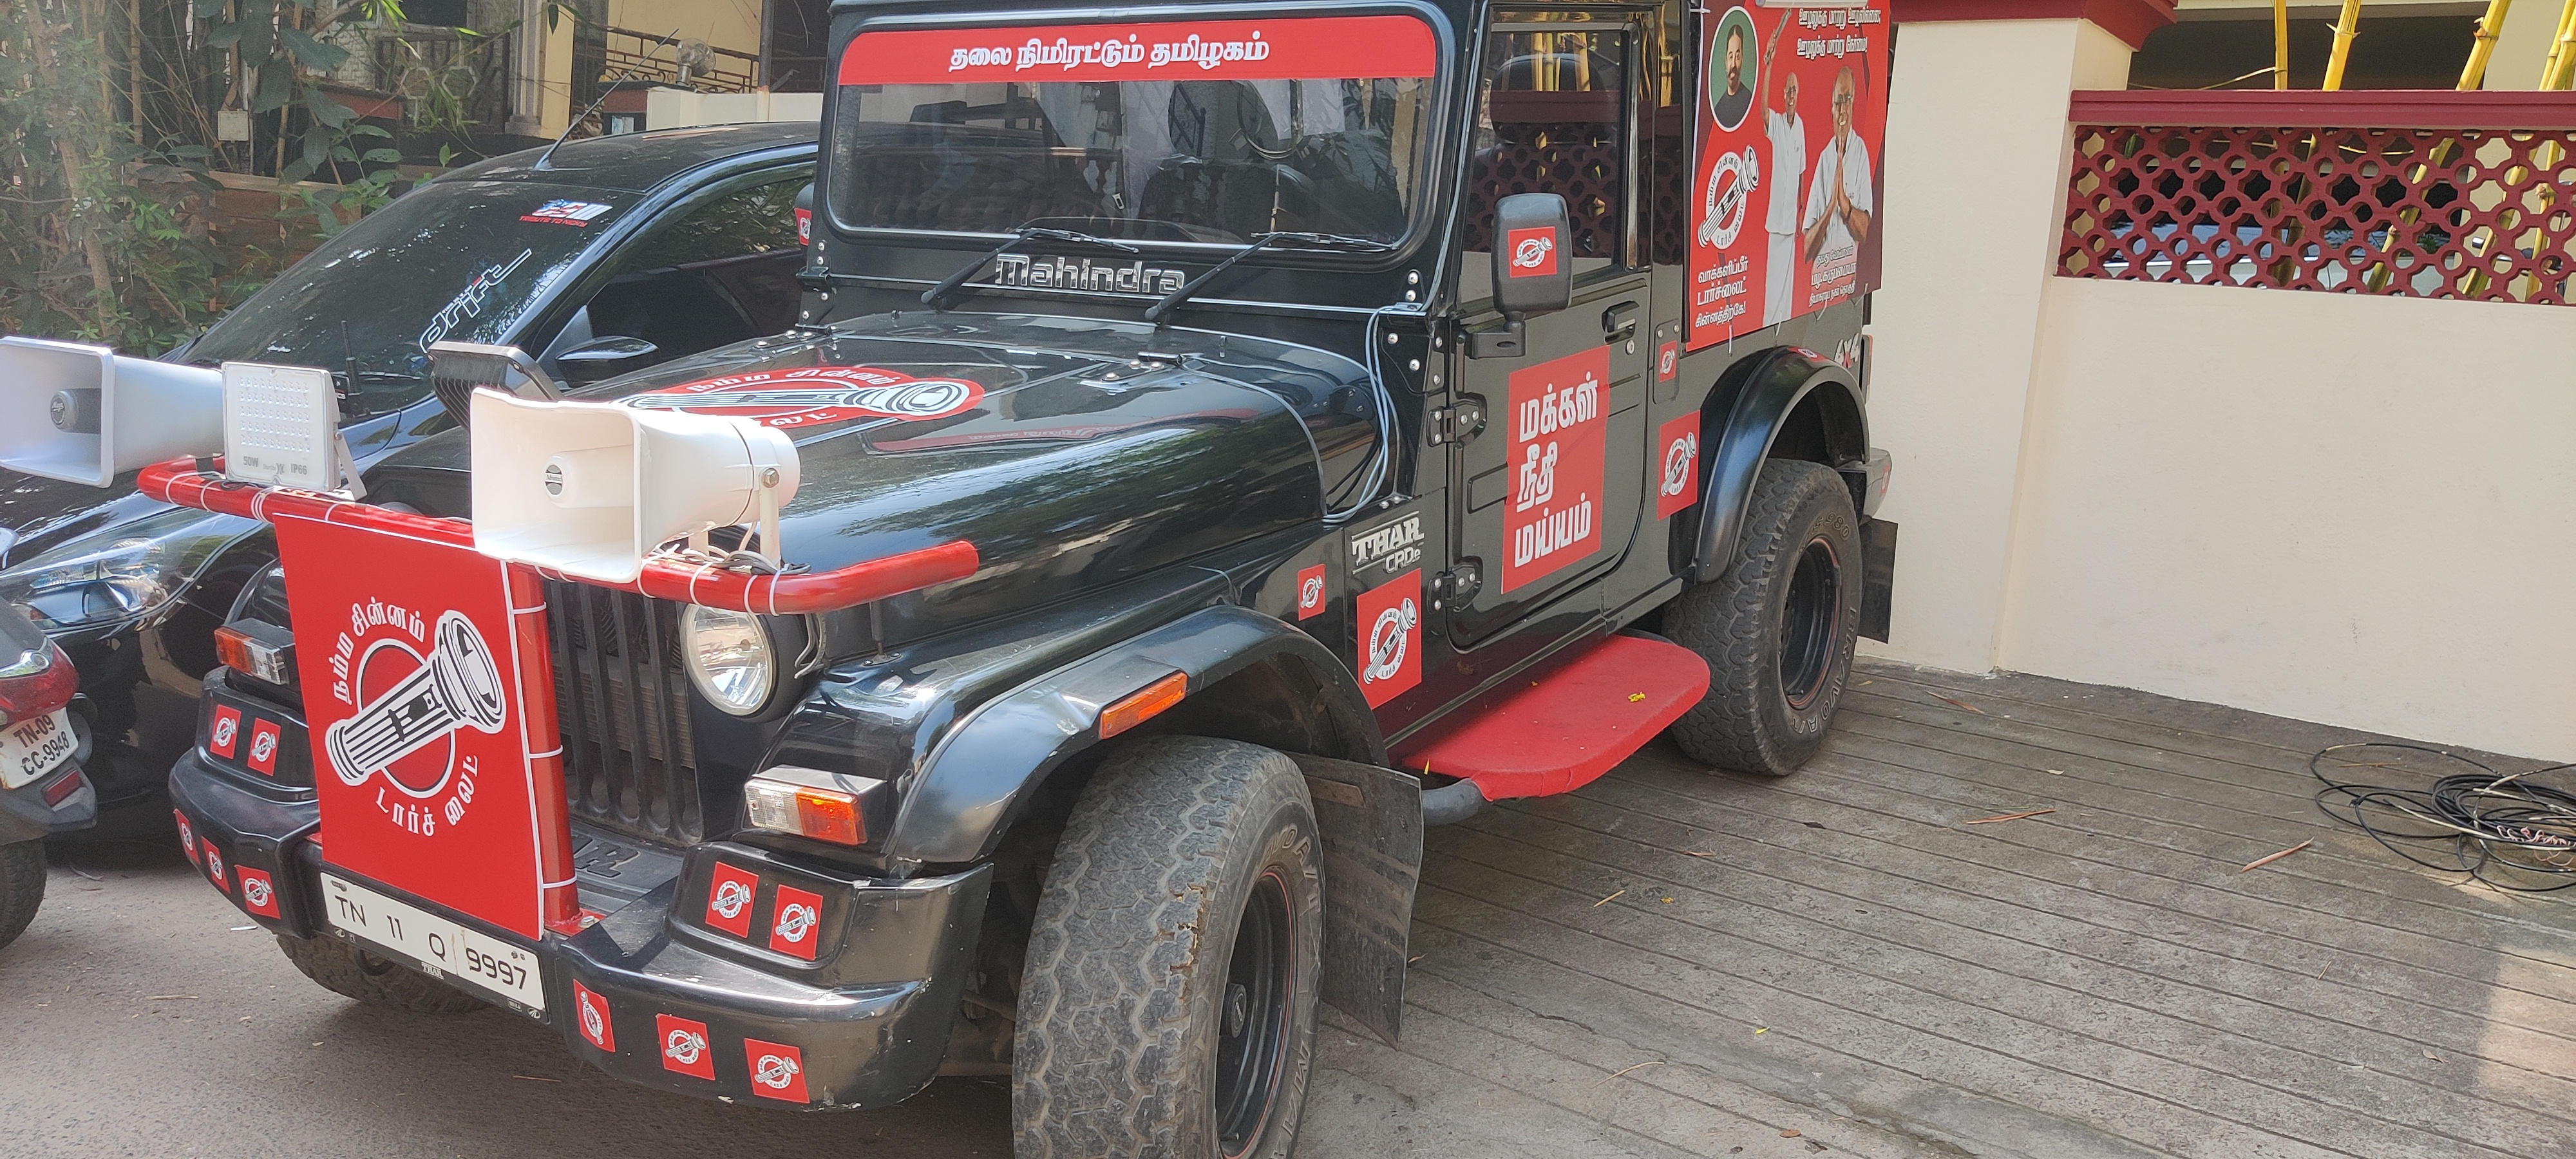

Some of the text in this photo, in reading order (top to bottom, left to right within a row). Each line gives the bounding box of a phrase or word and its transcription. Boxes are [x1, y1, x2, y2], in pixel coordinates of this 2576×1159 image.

[949, 30, 1269, 73] தலை நிமிரட்டும் தமிழகம்
[995, 252, 1186, 295] Mahindra
[1697, 276, 1747, 306] டார்ச்லைட்
[1698, 256, 1748, 283] வாக்களிப்பீர்
[419, 248, 533, 353] drift
[686, 369, 901, 393] நம்ம சின்னம்
[1519, 371, 1598, 443] மக்கள்
[243, 456, 258, 467] 50W
[290, 463, 307, 475] IP66
[1516, 441, 1558, 513] நீதி
[1352, 517, 1425, 567] THAR
[1514, 492, 1592, 568] மய்யம்
[1824, 512, 1850, 540] 980
[328, 596, 426, 706] நம்ம சின்னம்
[1821, 607, 1857, 721] BRAVO
[14, 715, 55, 748] TN-09
[21, 731, 69, 775] CC-9948
[375, 754, 479, 836] டார்ச் லைட்
[334, 894, 527, 990] TN 11 Q 9997
